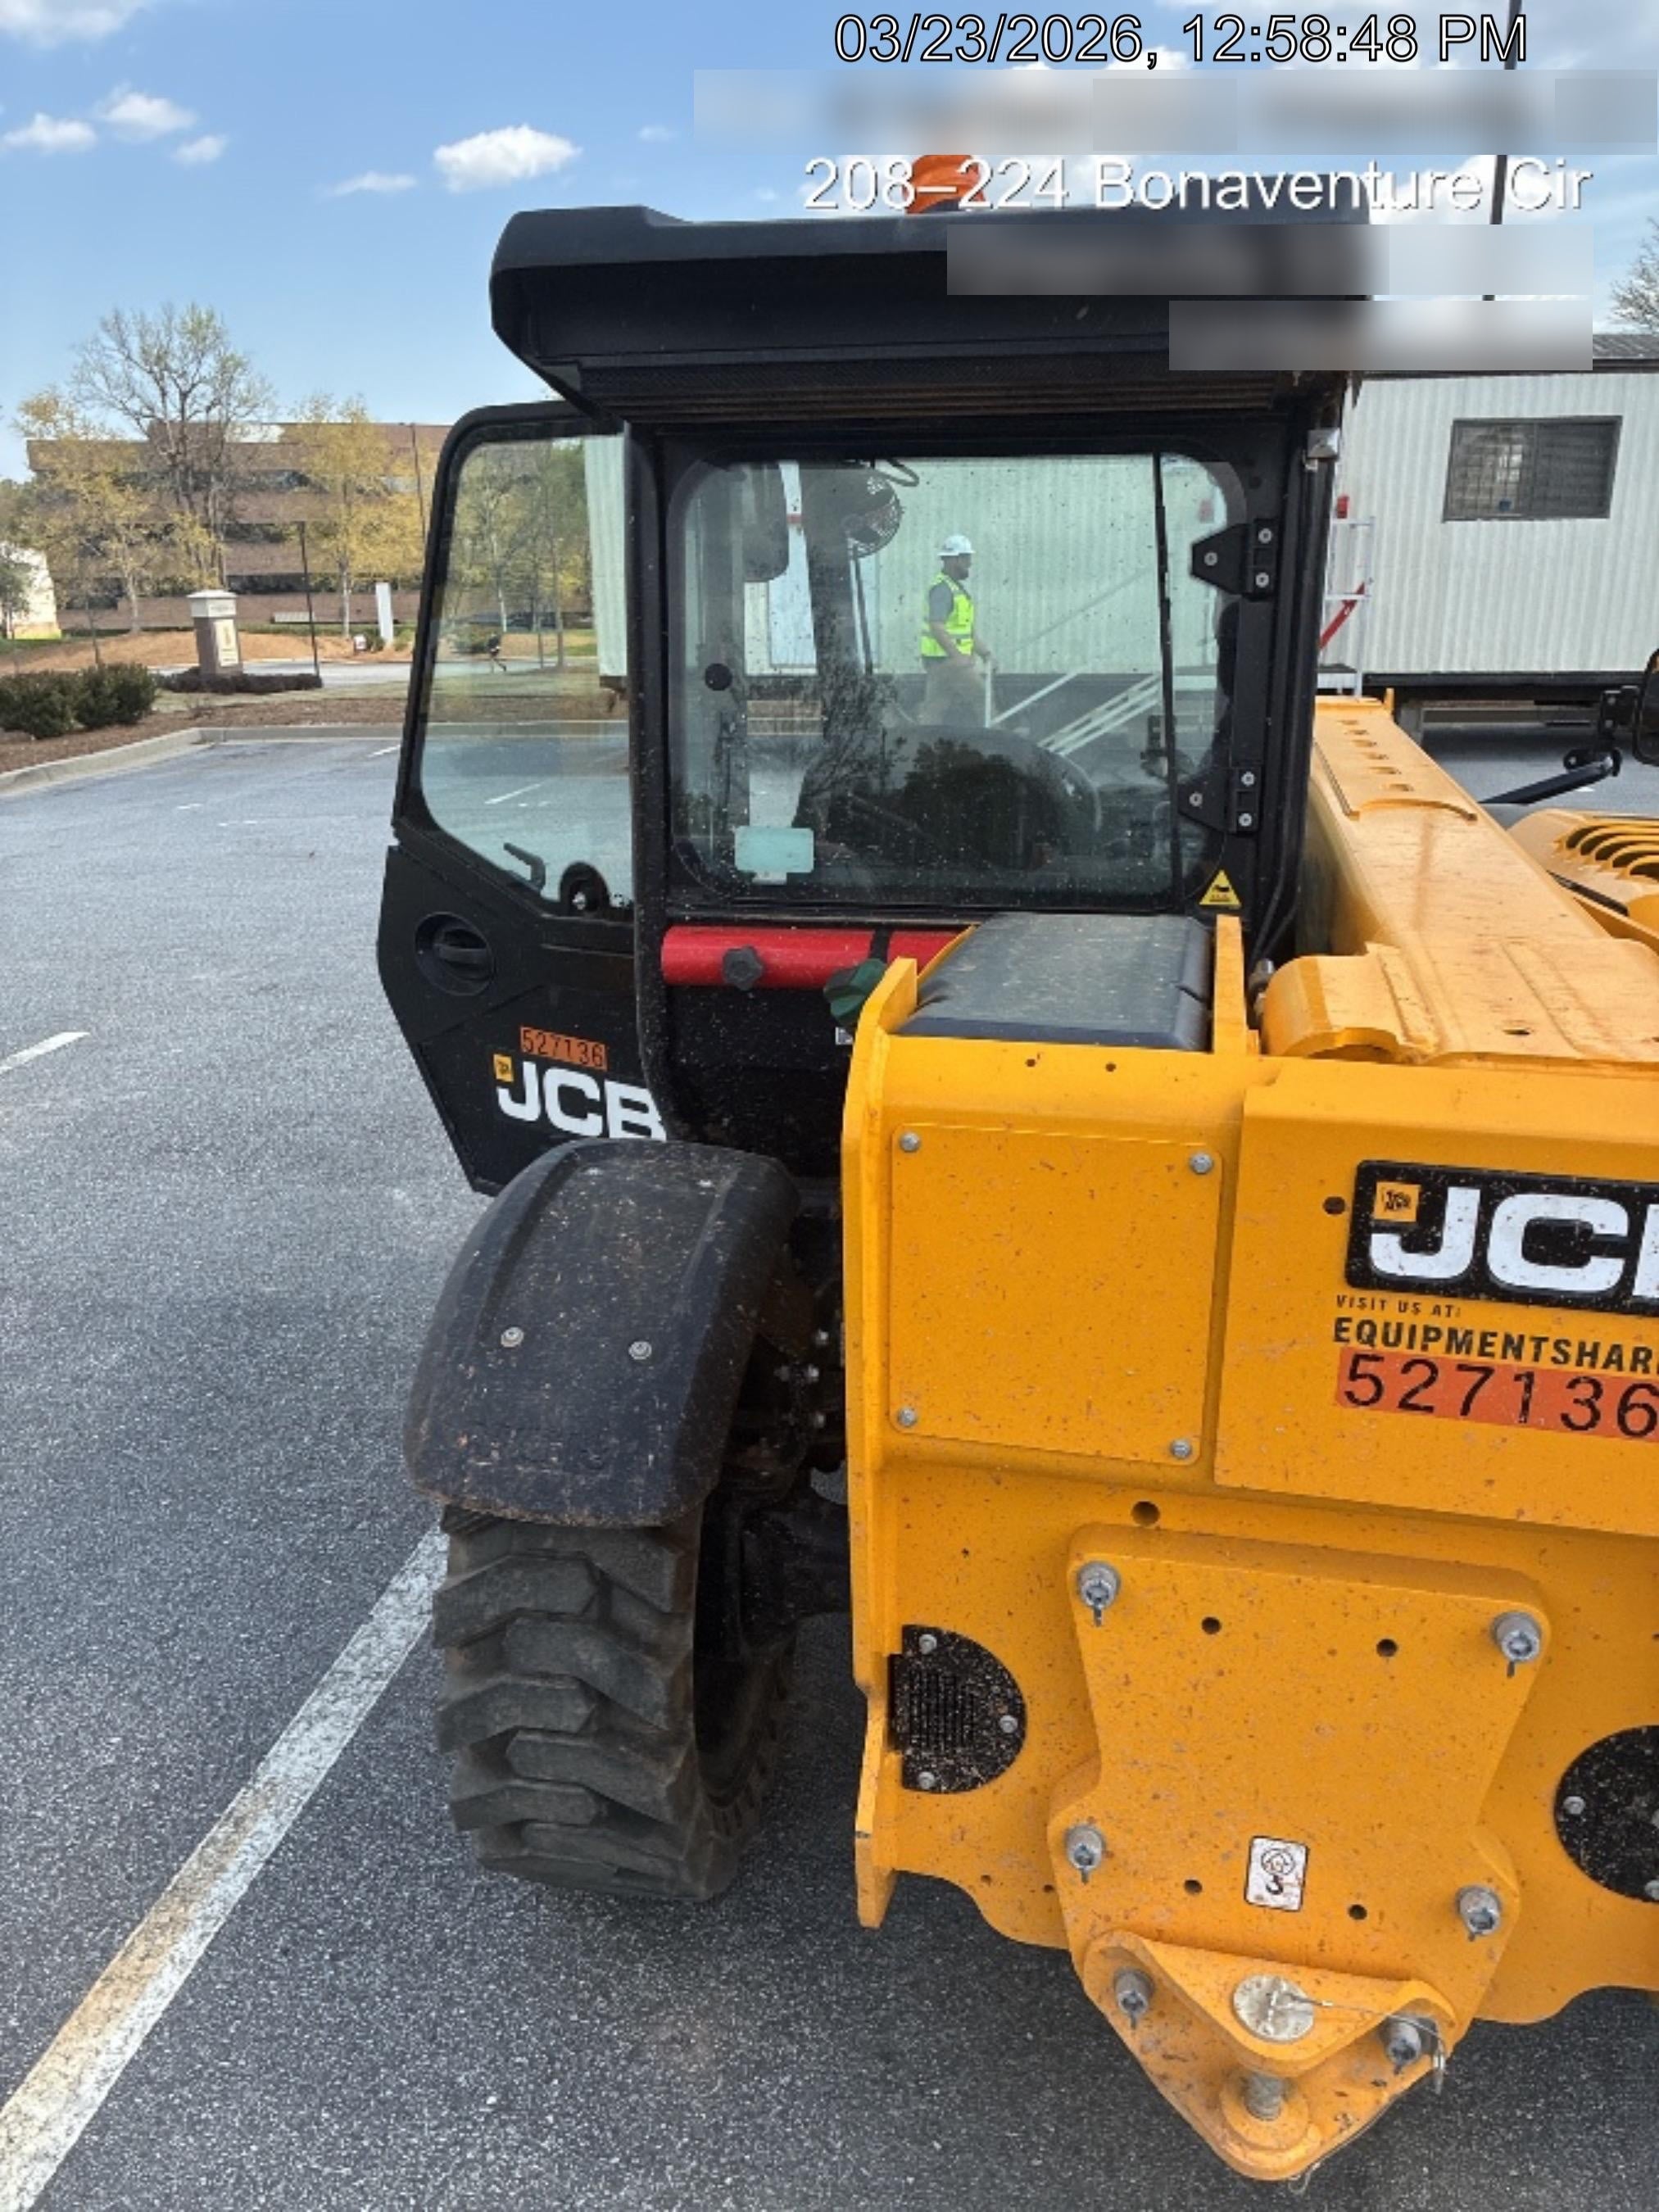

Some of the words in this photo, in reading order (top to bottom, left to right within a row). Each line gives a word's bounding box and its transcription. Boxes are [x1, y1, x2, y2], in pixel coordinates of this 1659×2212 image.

[523, 1030, 603, 1067] 527136
[496, 1061, 667, 1142] JCB
[1336, 1294, 1387, 1311] VISIT
[1398, 1299, 1421, 1314] US
[1333, 1317, 1659, 1375] EQUIPMENTSHAR
[1344, 1353, 1659, 1437] 527136
